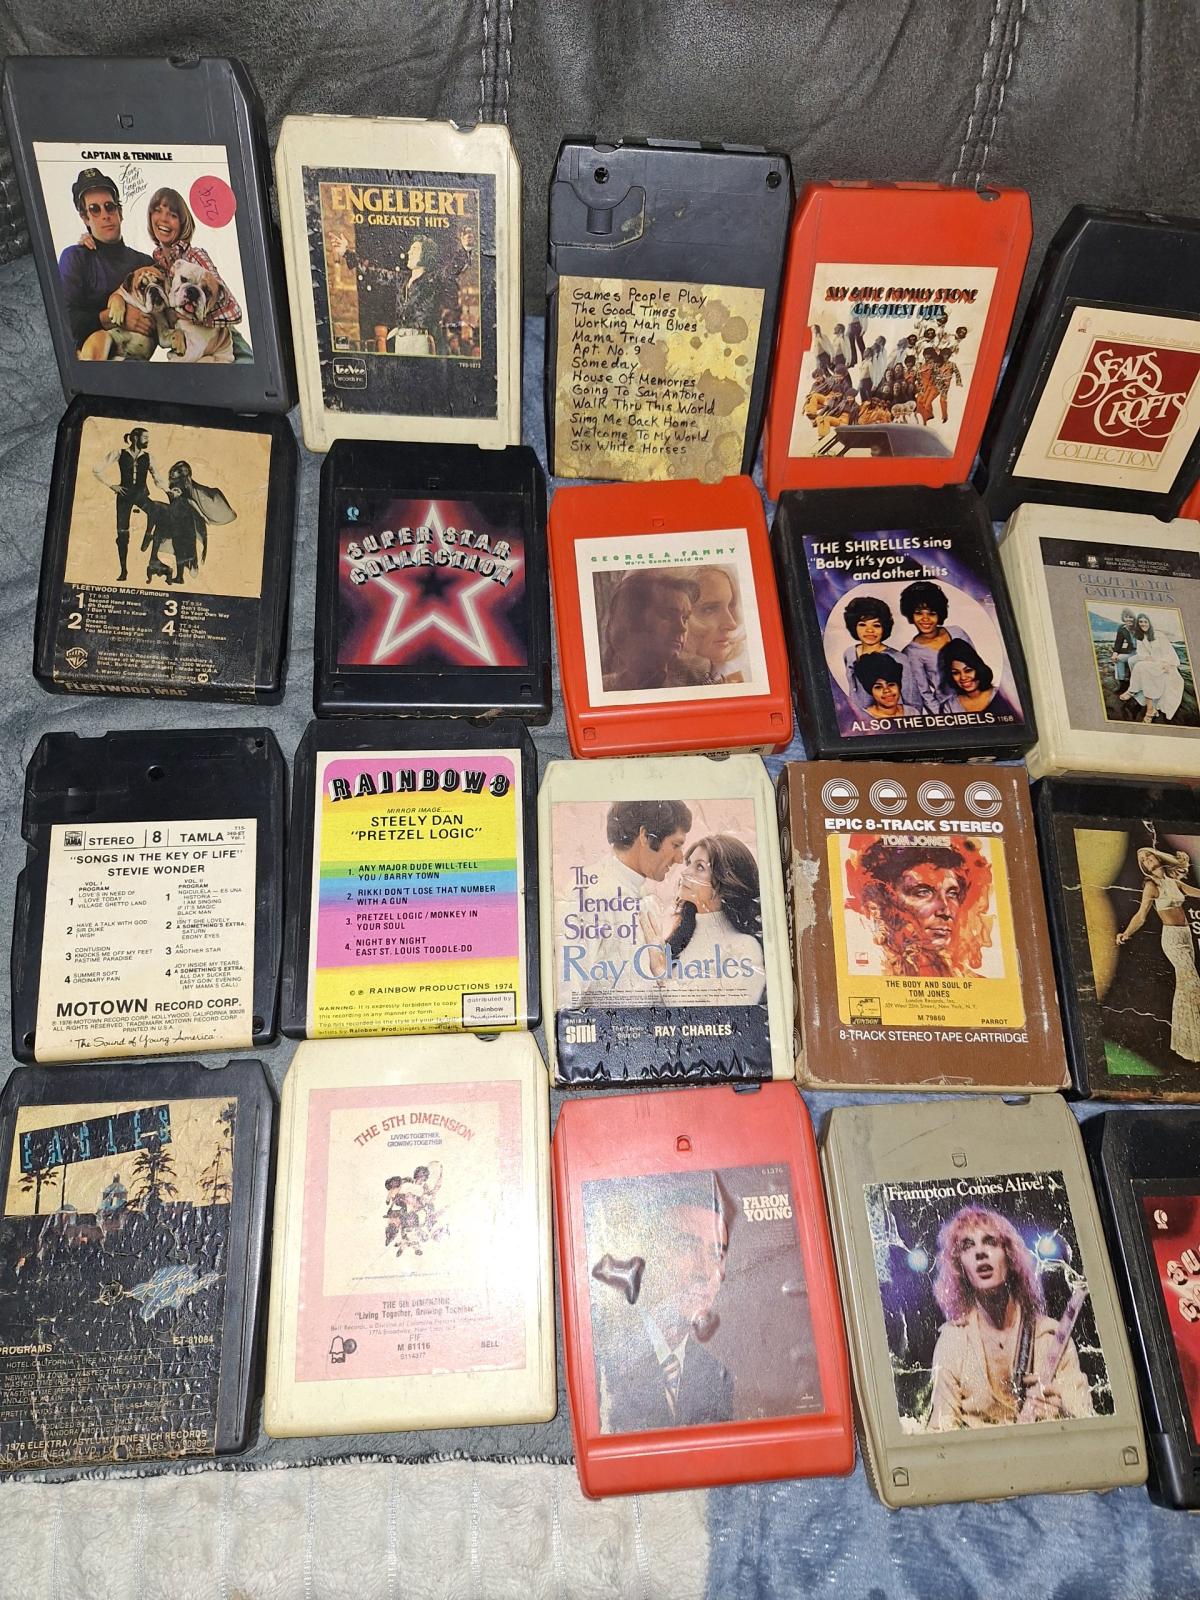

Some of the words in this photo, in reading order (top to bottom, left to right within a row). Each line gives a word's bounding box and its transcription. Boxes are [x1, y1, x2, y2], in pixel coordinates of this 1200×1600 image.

[81, 151, 121, 160] CAPTAIN
[123, 151, 130, 160] &
[131, 152, 173, 161] TENNILLE
[331, 187, 468, 216] ENGELBERT
[350, 213, 364, 224] 20
[368, 215, 420, 227] GREATEST
[425, 217, 450, 228] HITS
[573, 288, 621, 302] Games
[629, 287, 670, 302] People
[678, 288, 707, 309] Play
[825, 286, 849, 301] SLY
[861, 287, 885, 302] THE
[885, 287, 935, 303] FAMILY
[934, 288, 978, 304] STONE
[572, 303, 596, 316] The
[602, 303, 635, 316] Good
[640, 306, 676, 317] Times
[852, 303, 917, 319] GREATEST
[917, 304, 946, 320] HITS
[575, 317, 627, 333] Working
[633, 320, 660, 330] Man
[666, 320, 697, 332] Blues
[572, 332, 614, 343] Mama
[620, 333, 655, 345] Tried
[607, 342, 629, 355] No.
[634, 346, 641, 355] 9
[573, 372, 612, 384] House
[619, 372, 634, 385] Of
[639, 375, 696, 387] Memories
[1094, 388, 1187, 438] CROFTS
[1052, 442, 1159, 467] COLLECTION
[346, 526, 433, 560] SUPER
[443, 527, 512, 560] STAR
[811, 543, 840, 554] THE
[845, 538, 921, 553] SHIRELLES
[923, 537, 952, 549] sing
[591, 552, 654, 562] GEORGE
[681, 547, 736, 556] TAMMY
[810, 557, 852, 571] "Baby
[856, 555, 875, 567] it's
[878, 553, 910, 568] you"
[349, 548, 514, 587] COLLECTION
[853, 571, 881, 581] and
[882, 567, 921, 580] other
[922, 567, 948, 577] hits
[72, 584, 118, 593] FLEETWOOD
[119, 588, 170, 598] MAC/Rumours
[76, 593, 84, 608] 1
[164, 600, 177, 616] 3
[68, 613, 82, 630] 2
[162, 620, 175, 637] 4
[64, 683, 150, 694] FLEETWOOD
[156, 687, 188, 696] MAC
[852, 719, 891, 732] ALSO
[894, 717, 926, 729] THE
[926, 713, 995, 727] DECIBELS
[328, 768, 486, 802] RAINBOW
[489, 773, 510, 797] 8
[371, 815, 428, 827] STEELY
[432, 814, 463, 825] DAN
[824, 818, 862, 830] EPIC
[865, 819, 936, 832] 8-TRACK
[939, 820, 1003, 833] STEREO
[89, 836, 135, 846] STEREO
[152, 831, 162, 843] 8
[180, 832, 224, 843] TAMLA
[351, 830, 425, 841] "PRETZEL
[430, 827, 482, 839] LOGIC"
[71, 855, 118, 864] "SONGS
[123, 853, 134, 863] IN
[139, 852, 162, 861] THE
[165, 851, 189, 861] KEY
[192, 851, 209, 859] OF
[212, 849, 243, 858] LIFE"
[107, 867, 149, 877] STEVIE
[154, 864, 205, 875] WONDER
[378, 863, 408, 871] MAJOR
[410, 862, 433, 871] DUDE
[435, 862, 478, 870] WILL-TELL
[359, 873, 376, 881] YOU
[384, 872, 414, 880] BARRY
[416, 872, 440, 880] TOWN
[570, 866, 598, 885] The
[573, 886, 641, 913] Tender
[564, 913, 612, 940] Side
[617, 913, 638, 945] of
[356, 938, 383, 946] NIGHT
[399, 937, 426, 945] NIGHT
[356, 948, 377, 956] EAST
[379, 947, 392, 956] ST.
[395, 946, 420, 955] LOUIS
[562, 945, 628, 987] Ray
[633, 943, 754, 981] Charles
[369, 986, 416, 995] RAINBOW
[419, 983, 490, 992] PRODUCTIONS
[886, 980, 901, 989] THE
[902, 981, 921, 989] BODY
[923, 981, 939, 989] AND
[941, 981, 961, 989] SOUL
[926, 990, 950, 998] JONES
[56, 998, 148, 1018] MOTOWN
[155, 999, 203, 1012] RECORD
[207, 998, 242, 1008] CORP.
[655, 1025, 676, 1037] RAY
[682, 1024, 732, 1036] CHARLES
[839, 1029, 887, 1041] 8-TRACK
[888, 1030, 932, 1042] STEREO
[935, 1031, 963, 1042] TAPE
[965, 1031, 1029, 1043] CARTRIDGE
[96, 1037, 125, 1048] Sound
[128, 1034, 137, 1047] of
[139, 1034, 169, 1050] Young
[354, 1124, 380, 1148] THE
[382, 1114, 406, 1132] 5TH
[410, 1112, 476, 1142] DIMENSION
[387, 1140, 414, 1148] GROWING
[414, 1138, 442, 1146] TOGETHER
[888, 1182, 955, 1202] Frampton
[957, 1180, 1004, 1197] Comes
[1005, 1176, 1044, 1193] Alive!
[742, 1194, 789, 1209] FARON
[744, 1207, 792, 1222] YOUNG
[480, 1340, 499, 1348] BELL
